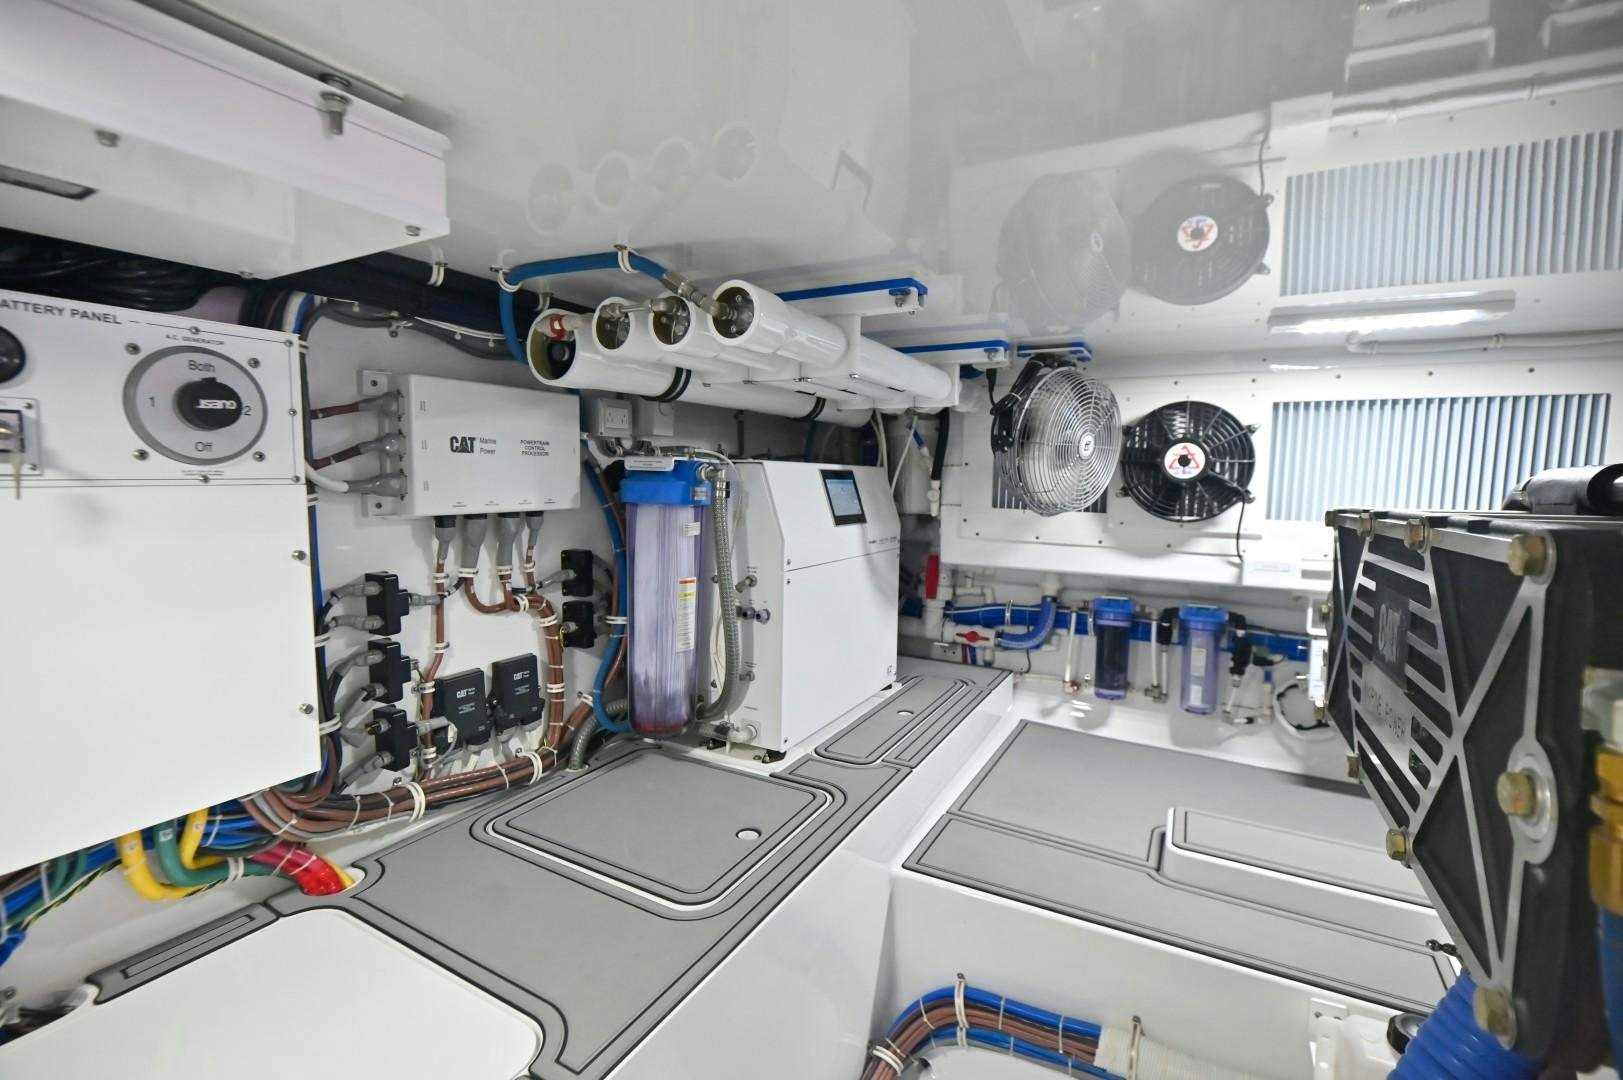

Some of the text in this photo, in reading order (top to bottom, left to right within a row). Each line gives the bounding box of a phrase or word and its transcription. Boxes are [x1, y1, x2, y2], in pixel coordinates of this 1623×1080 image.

[0, 299, 122, 325] ATTERY PANEL
[188, 359, 216, 373] Both
[194, 398, 238, 410] GUEST
[243, 404, 252, 417] 2
[195, 440, 214, 453] Off
[450, 436, 477, 453] CAT
[479, 447, 497, 455] Power
[513, 672, 524, 681] CAT
[456, 689, 467, 699] CAT
